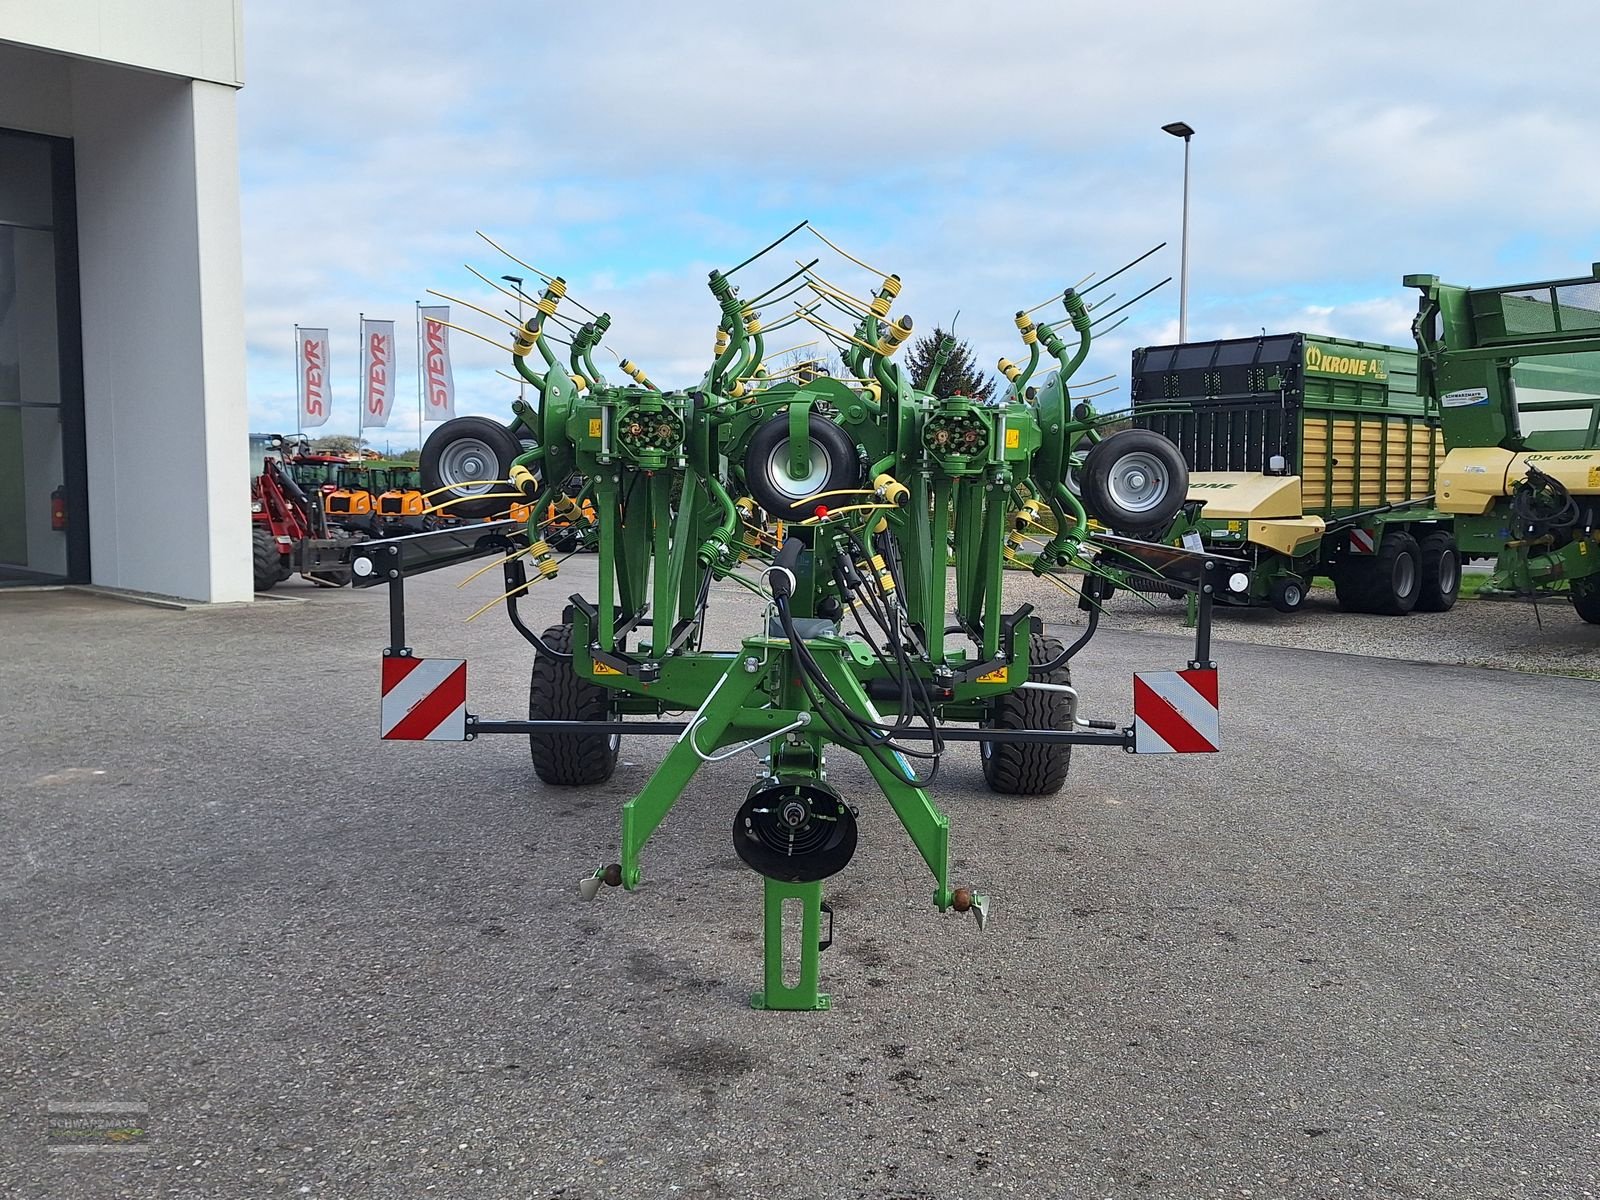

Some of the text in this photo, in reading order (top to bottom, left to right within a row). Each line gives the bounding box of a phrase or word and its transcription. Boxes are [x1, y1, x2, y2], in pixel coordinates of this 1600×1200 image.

[305, 339, 322, 417] STEYR
[369, 333, 386, 416] STEYR
[427, 320, 447, 410] STEYR
[1321, 355, 1367, 376] KRONE
